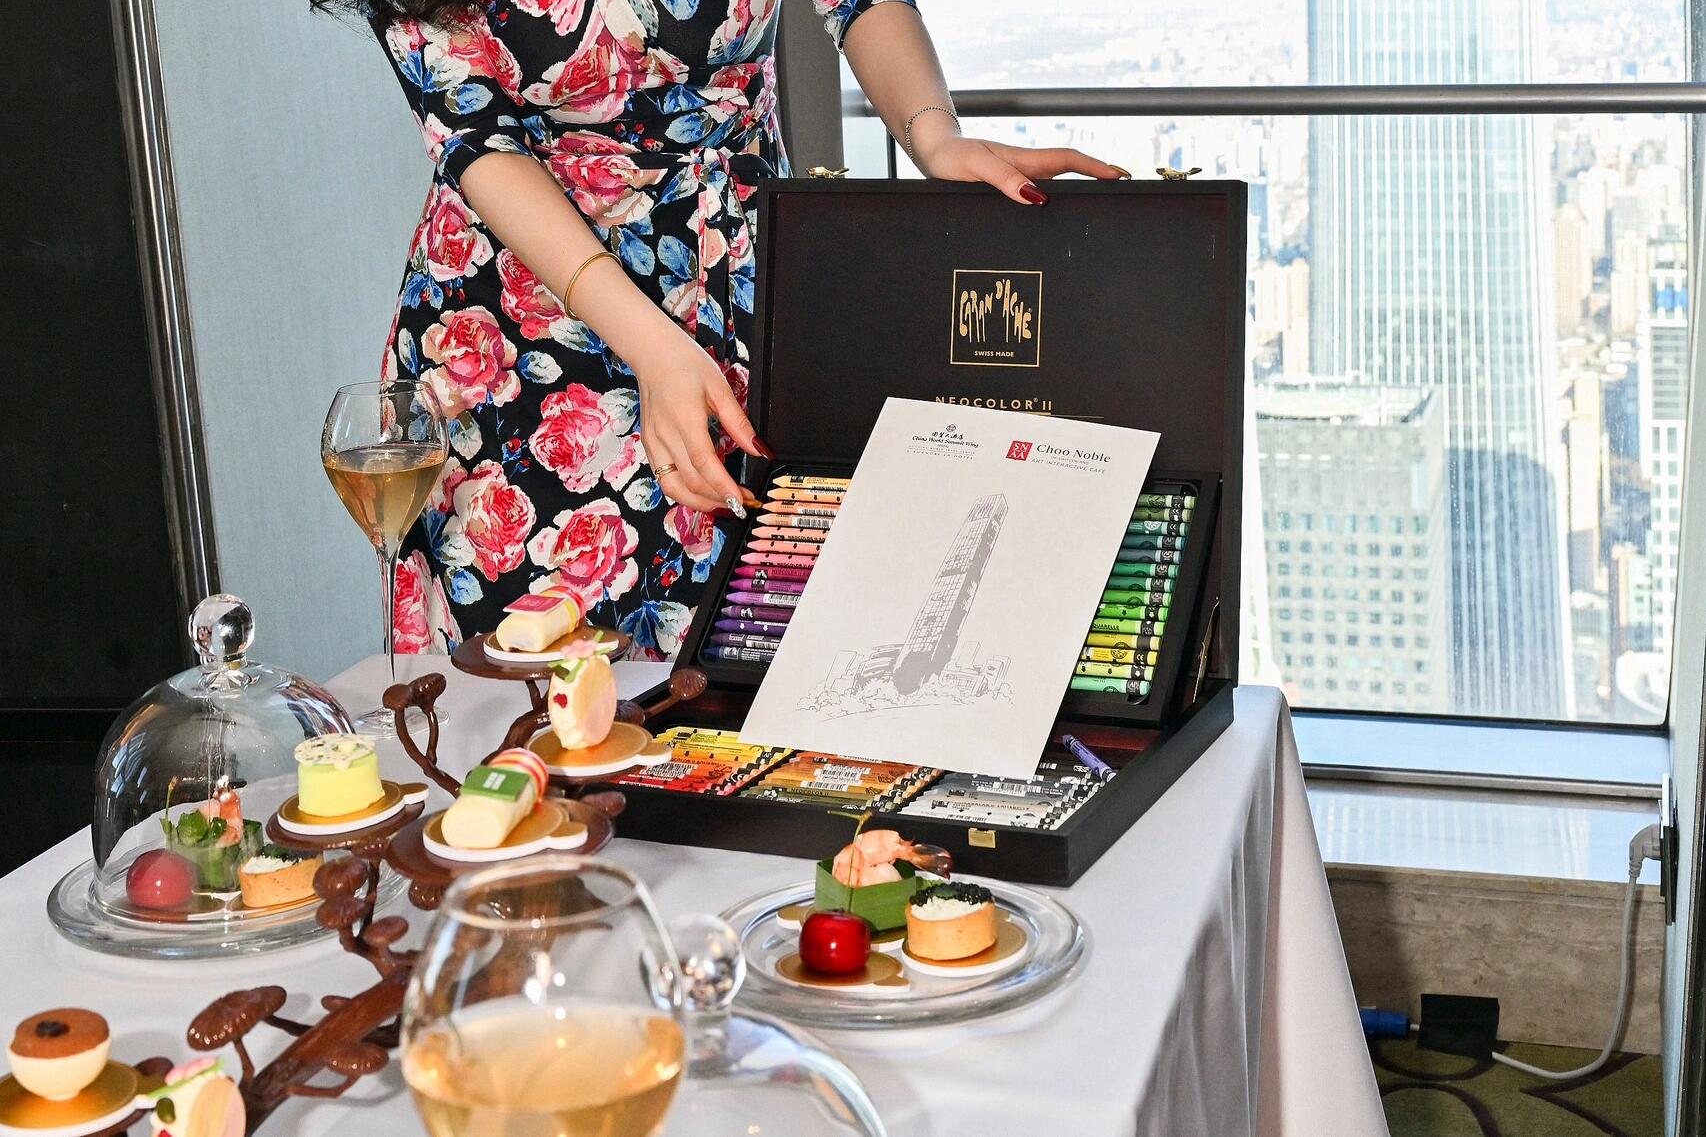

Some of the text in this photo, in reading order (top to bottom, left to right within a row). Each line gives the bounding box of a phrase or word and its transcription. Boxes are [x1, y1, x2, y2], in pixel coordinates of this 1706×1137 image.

[959, 290, 994, 343] CARAN
[1043, 400, 1052, 411] II
[1036, 444, 1111, 463] Choo Noble
[1046, 460, 1088, 471] INTERACTIVE
